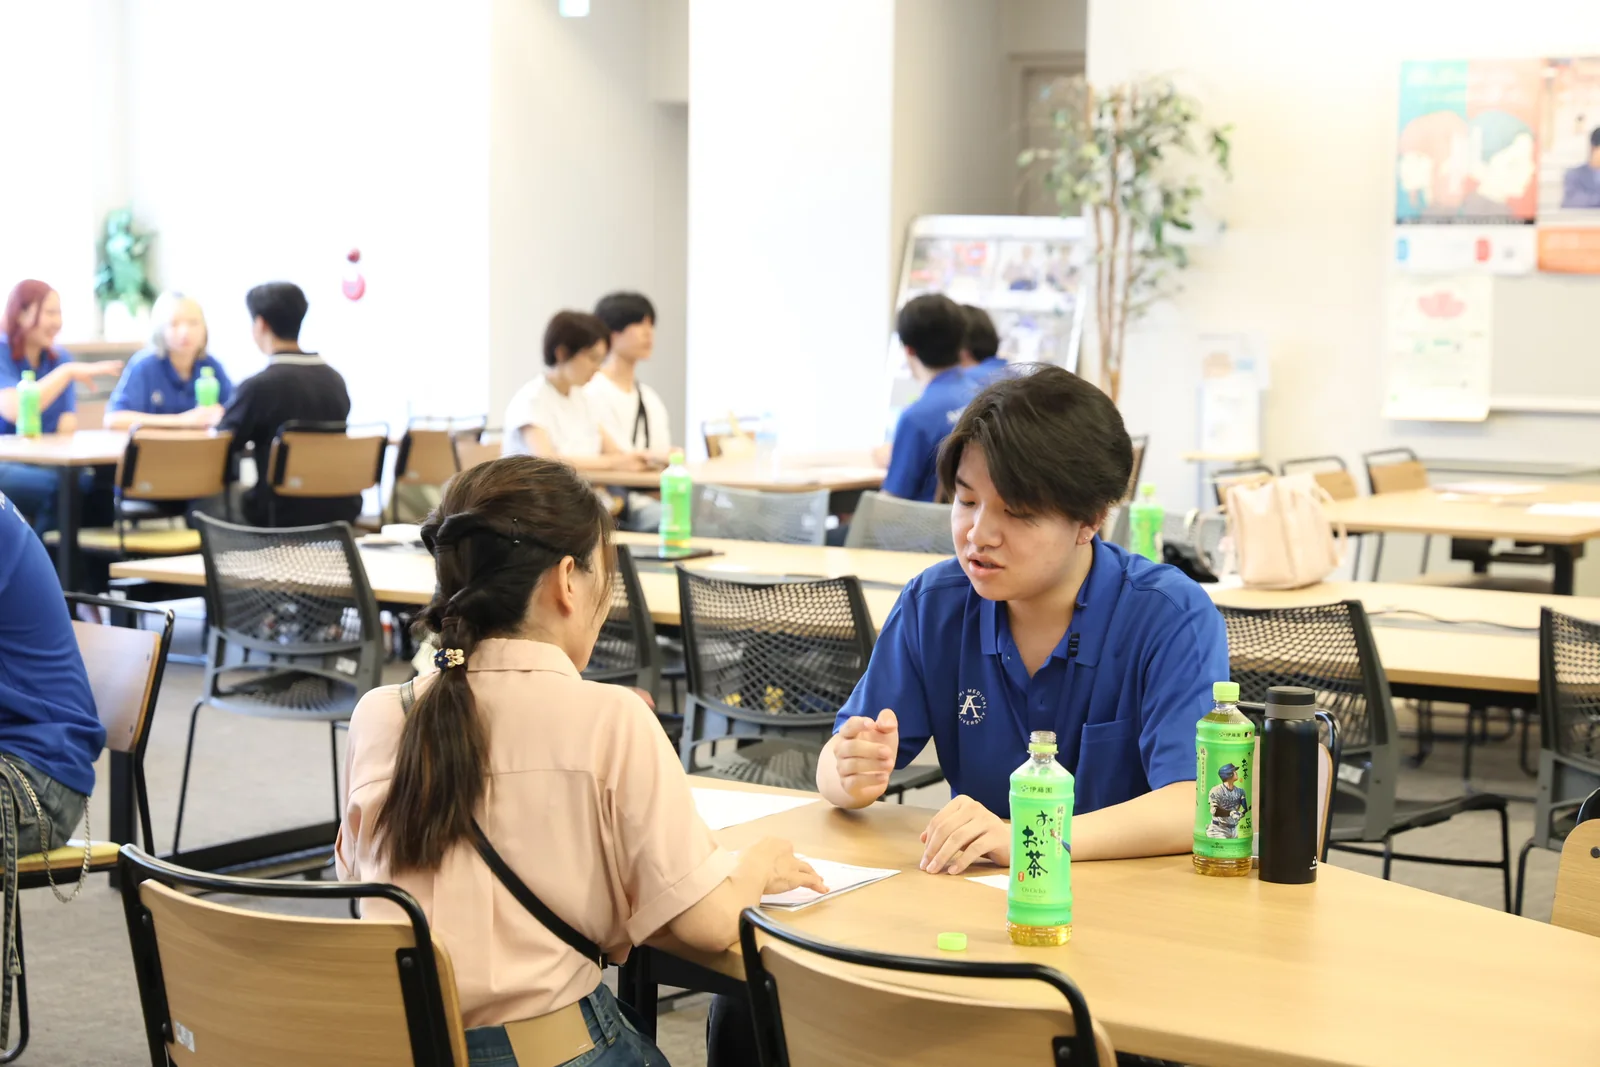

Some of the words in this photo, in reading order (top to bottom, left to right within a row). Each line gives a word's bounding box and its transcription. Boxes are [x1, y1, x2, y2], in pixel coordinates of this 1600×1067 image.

[967, 688, 987, 709] MEDICAL
[958, 712, 986, 726] NIVERSITY
[1022, 825, 1049, 879] お茶
